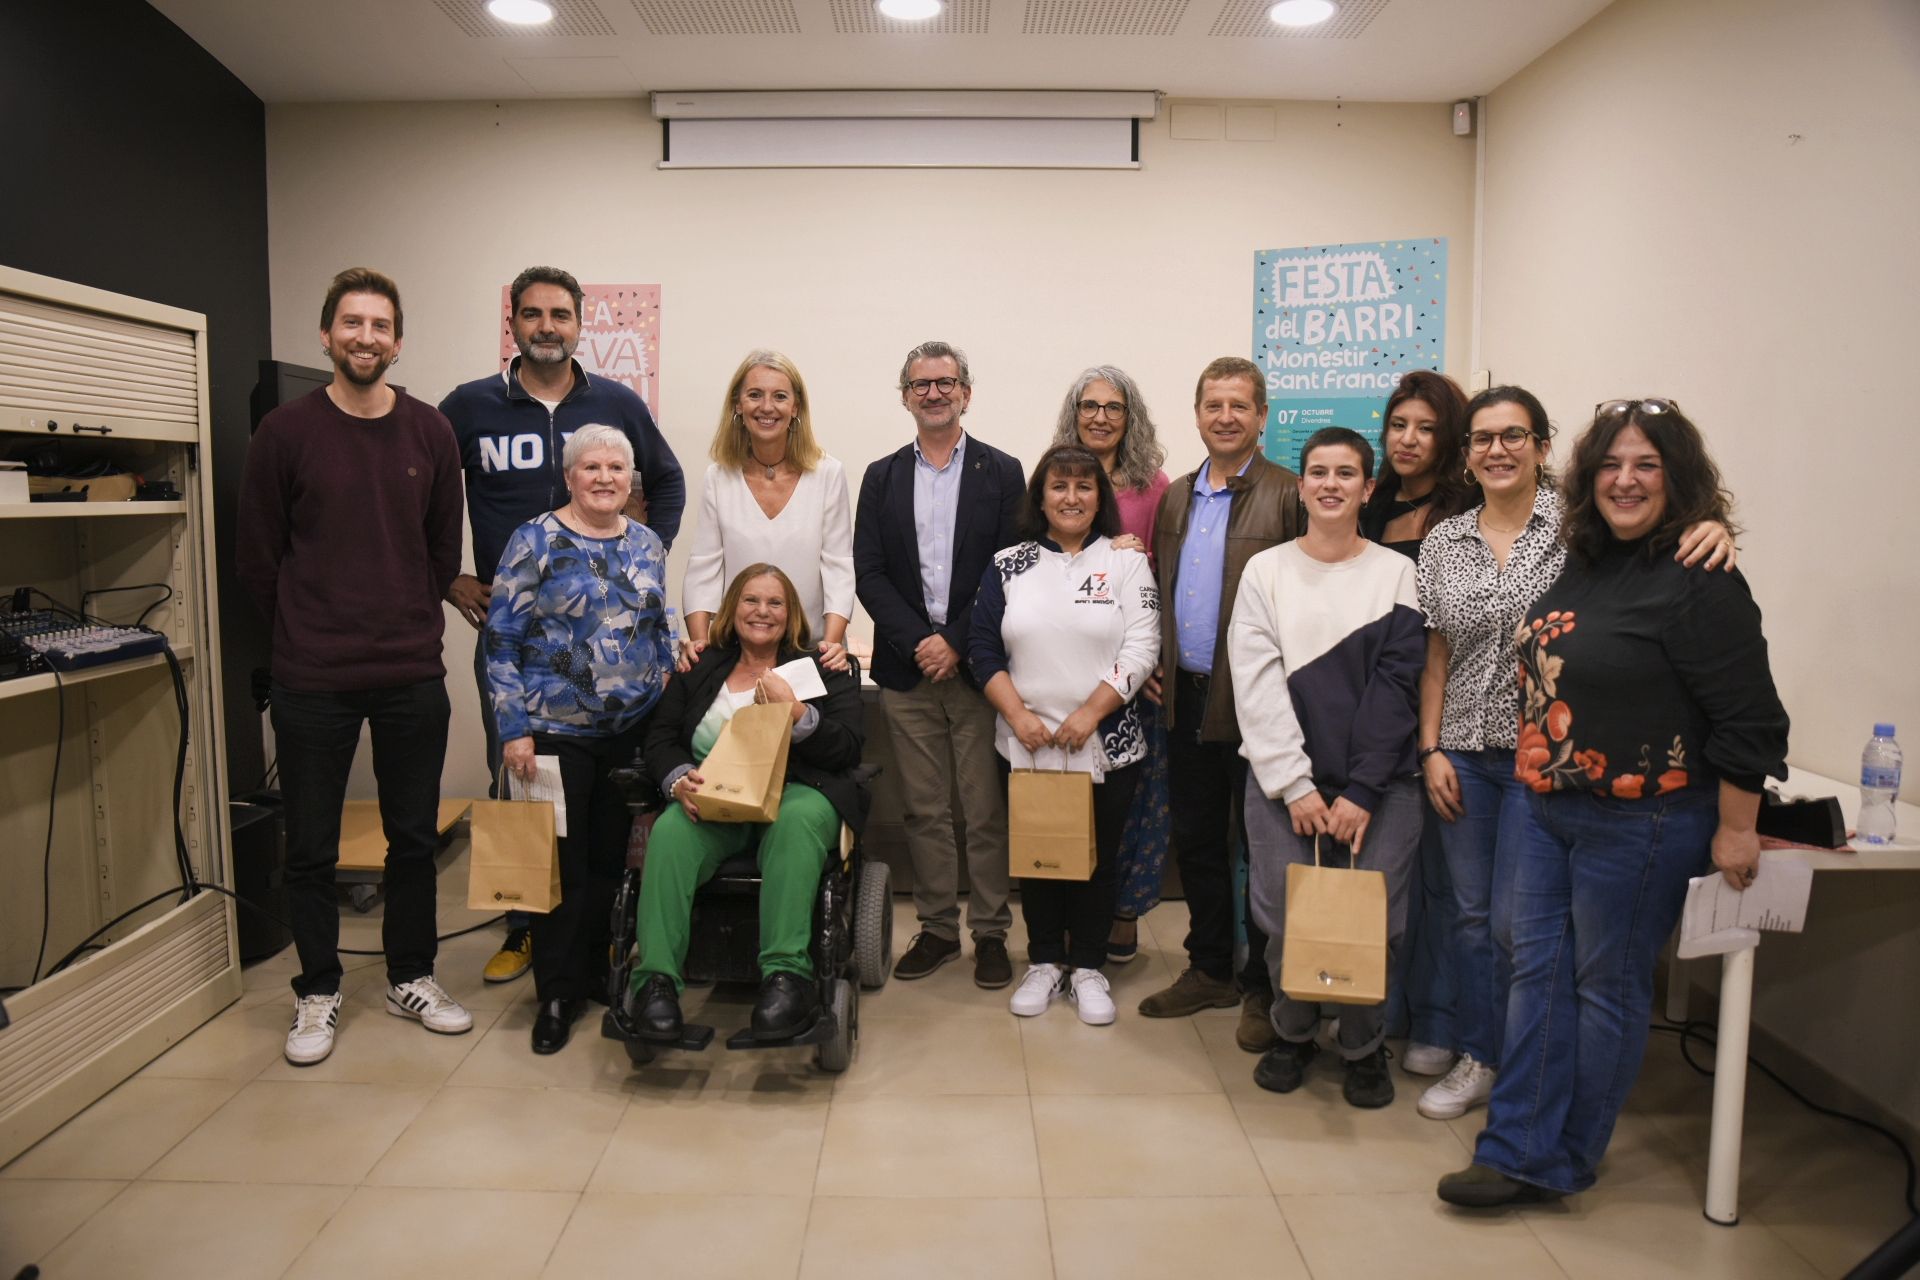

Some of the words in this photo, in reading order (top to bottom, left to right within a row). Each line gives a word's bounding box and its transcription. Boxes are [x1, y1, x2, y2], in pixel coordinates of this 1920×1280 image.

[1278, 260, 1387, 302] FESTA
[1265, 315, 1300, 340] del
[1303, 303, 1414, 346] BARRI
[1267, 345, 1369, 369] Monestir
[1266, 370, 1322, 391] Sant
[1323, 369, 1402, 390] France
[1278, 409, 1298, 425] 07
[479, 432, 544, 474] NO
